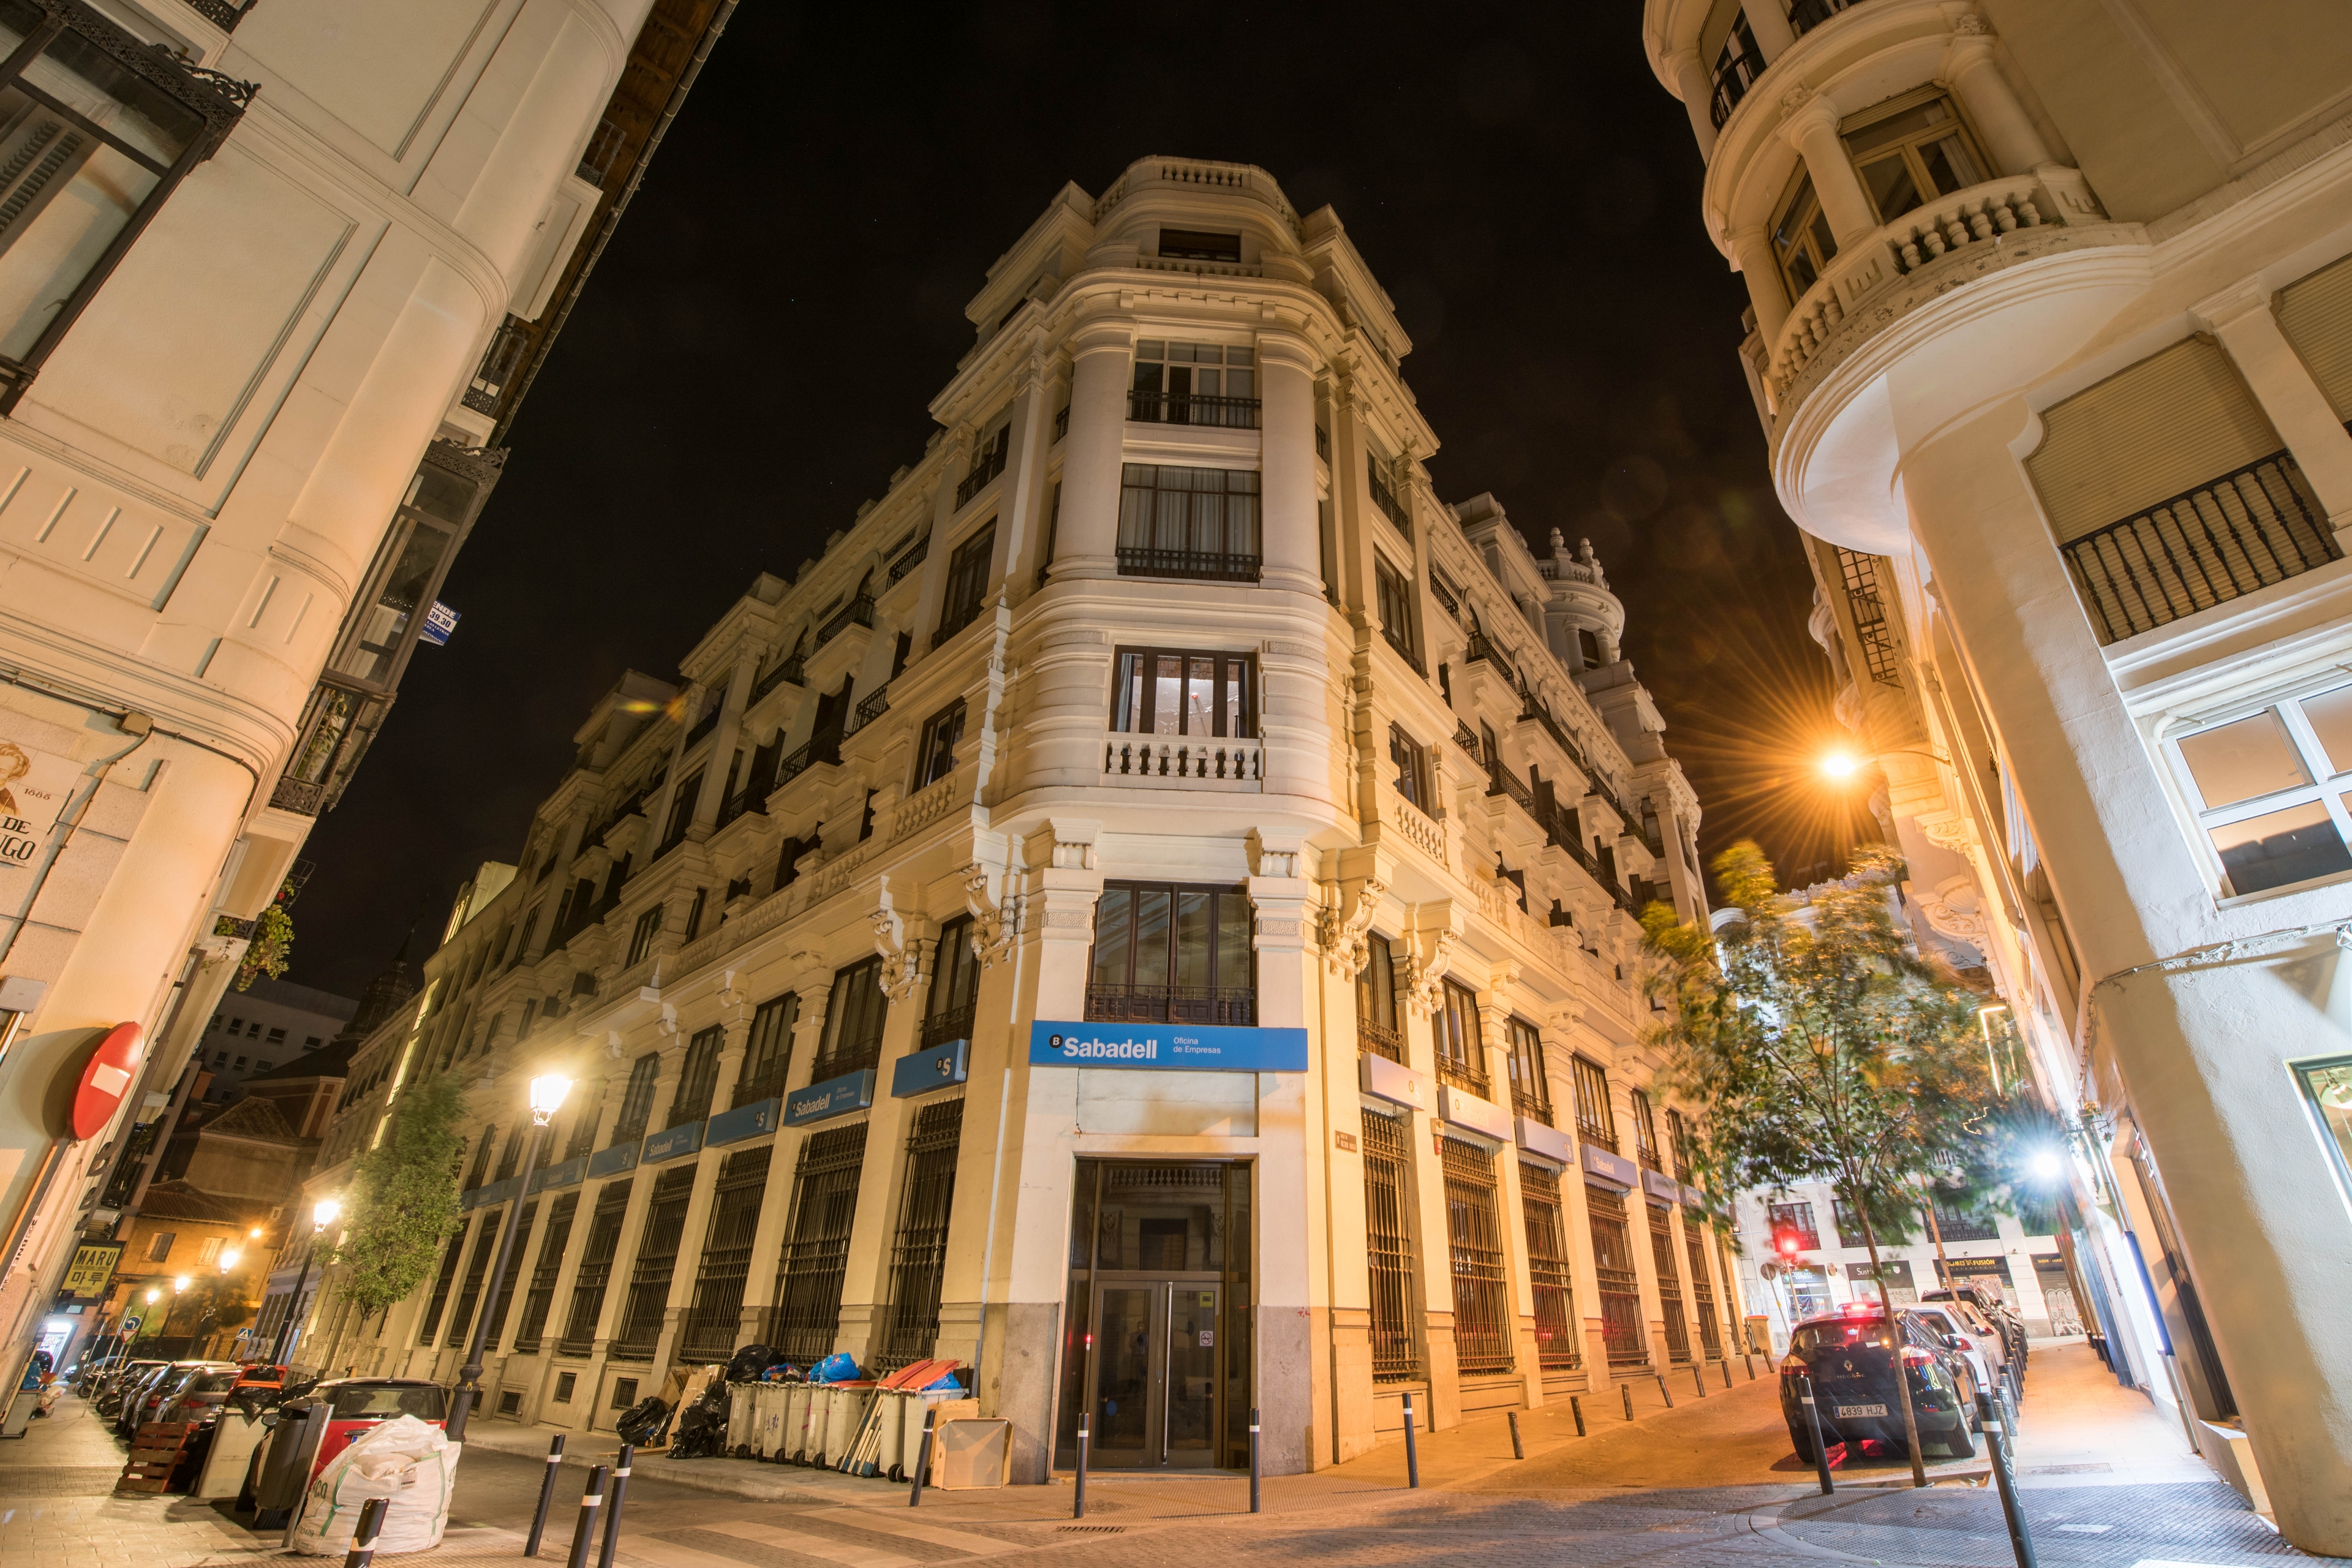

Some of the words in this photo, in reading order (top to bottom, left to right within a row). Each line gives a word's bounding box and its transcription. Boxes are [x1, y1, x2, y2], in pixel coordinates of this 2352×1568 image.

[433, 601, 456, 619] ENDE
[424, 624, 435, 632] UECA
[429, 611, 451, 628] 39.30
[24, 788, 51, 800] 1885
[0, 816, 31, 834] DE
[1063, 1037, 1157, 1059] Sabadell
[1185, 1046, 1221, 1055] Empresas
[795, 1093, 831, 1117] Sabadell
[1460, 1102, 1490, 1128] Sabadell
[649, 1138, 673, 1157] Sabadell
[1596, 1156, 1615, 1175] Sabadell
[75, 1250, 116, 1266] MARU
[1841, 1406, 1863, 1416] 4839
[1866, 1406, 1883, 1415] HJZ
